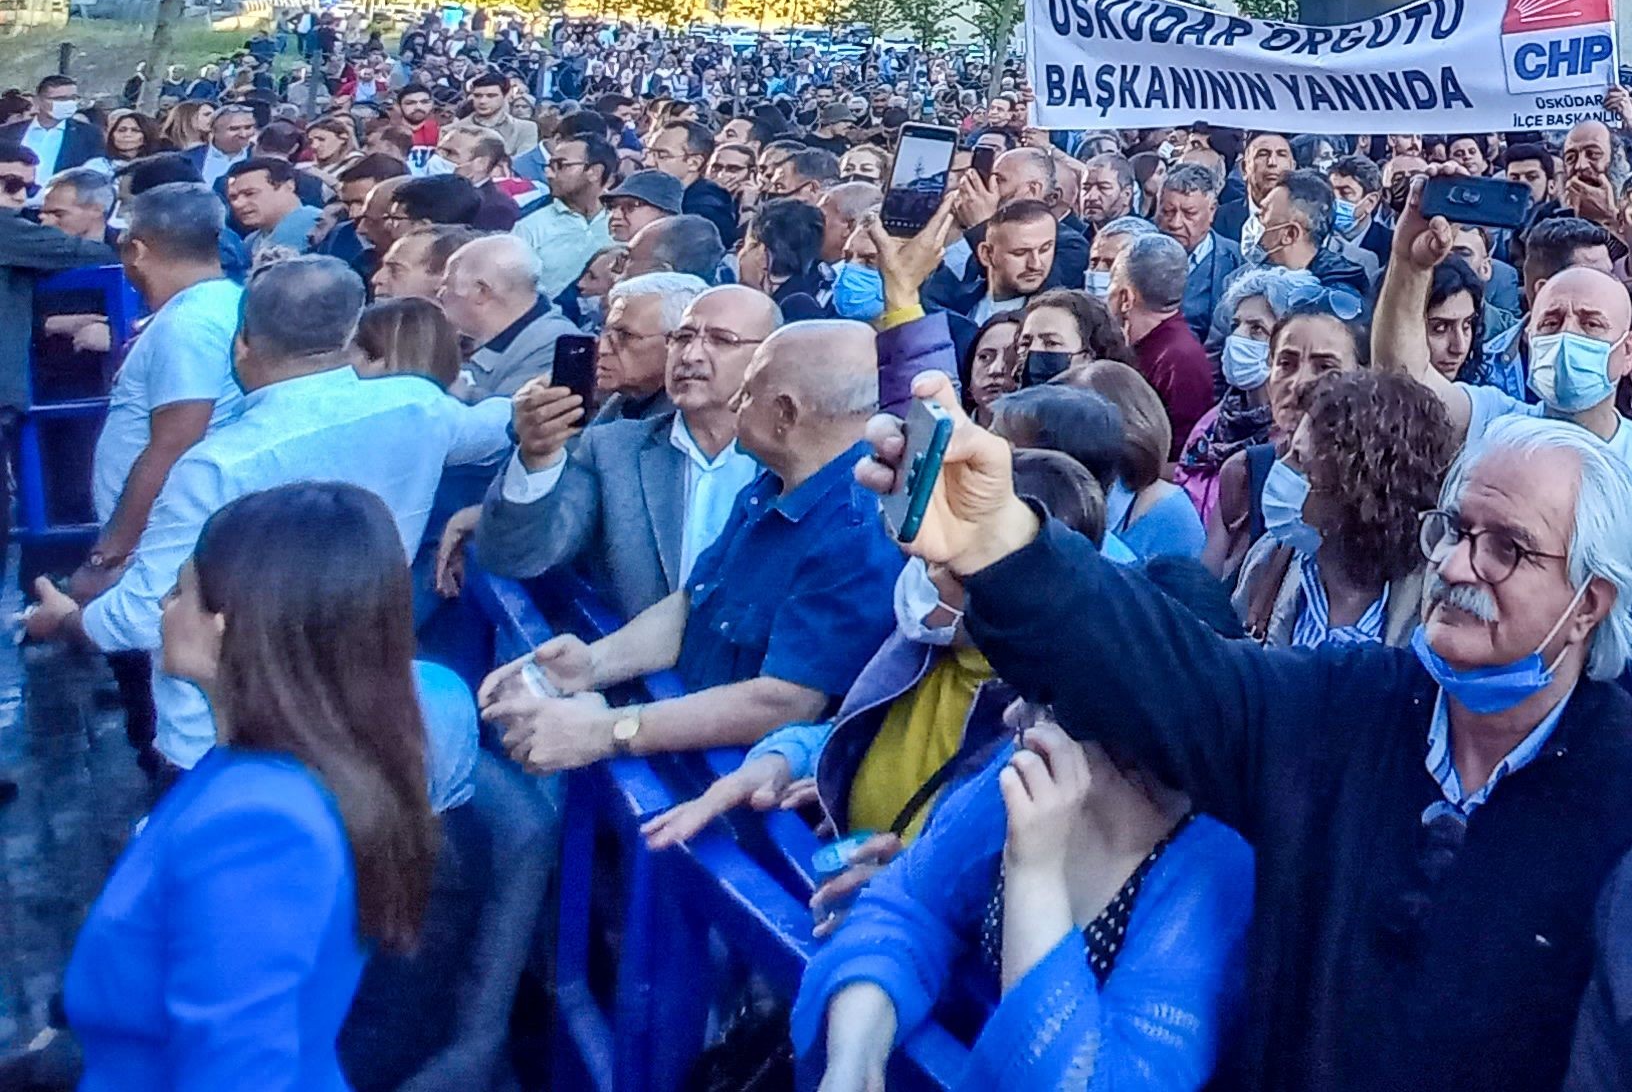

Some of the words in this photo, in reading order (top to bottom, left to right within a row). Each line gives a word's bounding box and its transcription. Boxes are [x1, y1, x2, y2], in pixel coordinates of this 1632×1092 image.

[1514, 35, 1613, 81] CHP
[1046, 64, 1276, 117] BAŞKANININ
[1273, 66, 1474, 110] YANINDA
[1513, 113, 1543, 128] İLÇE
